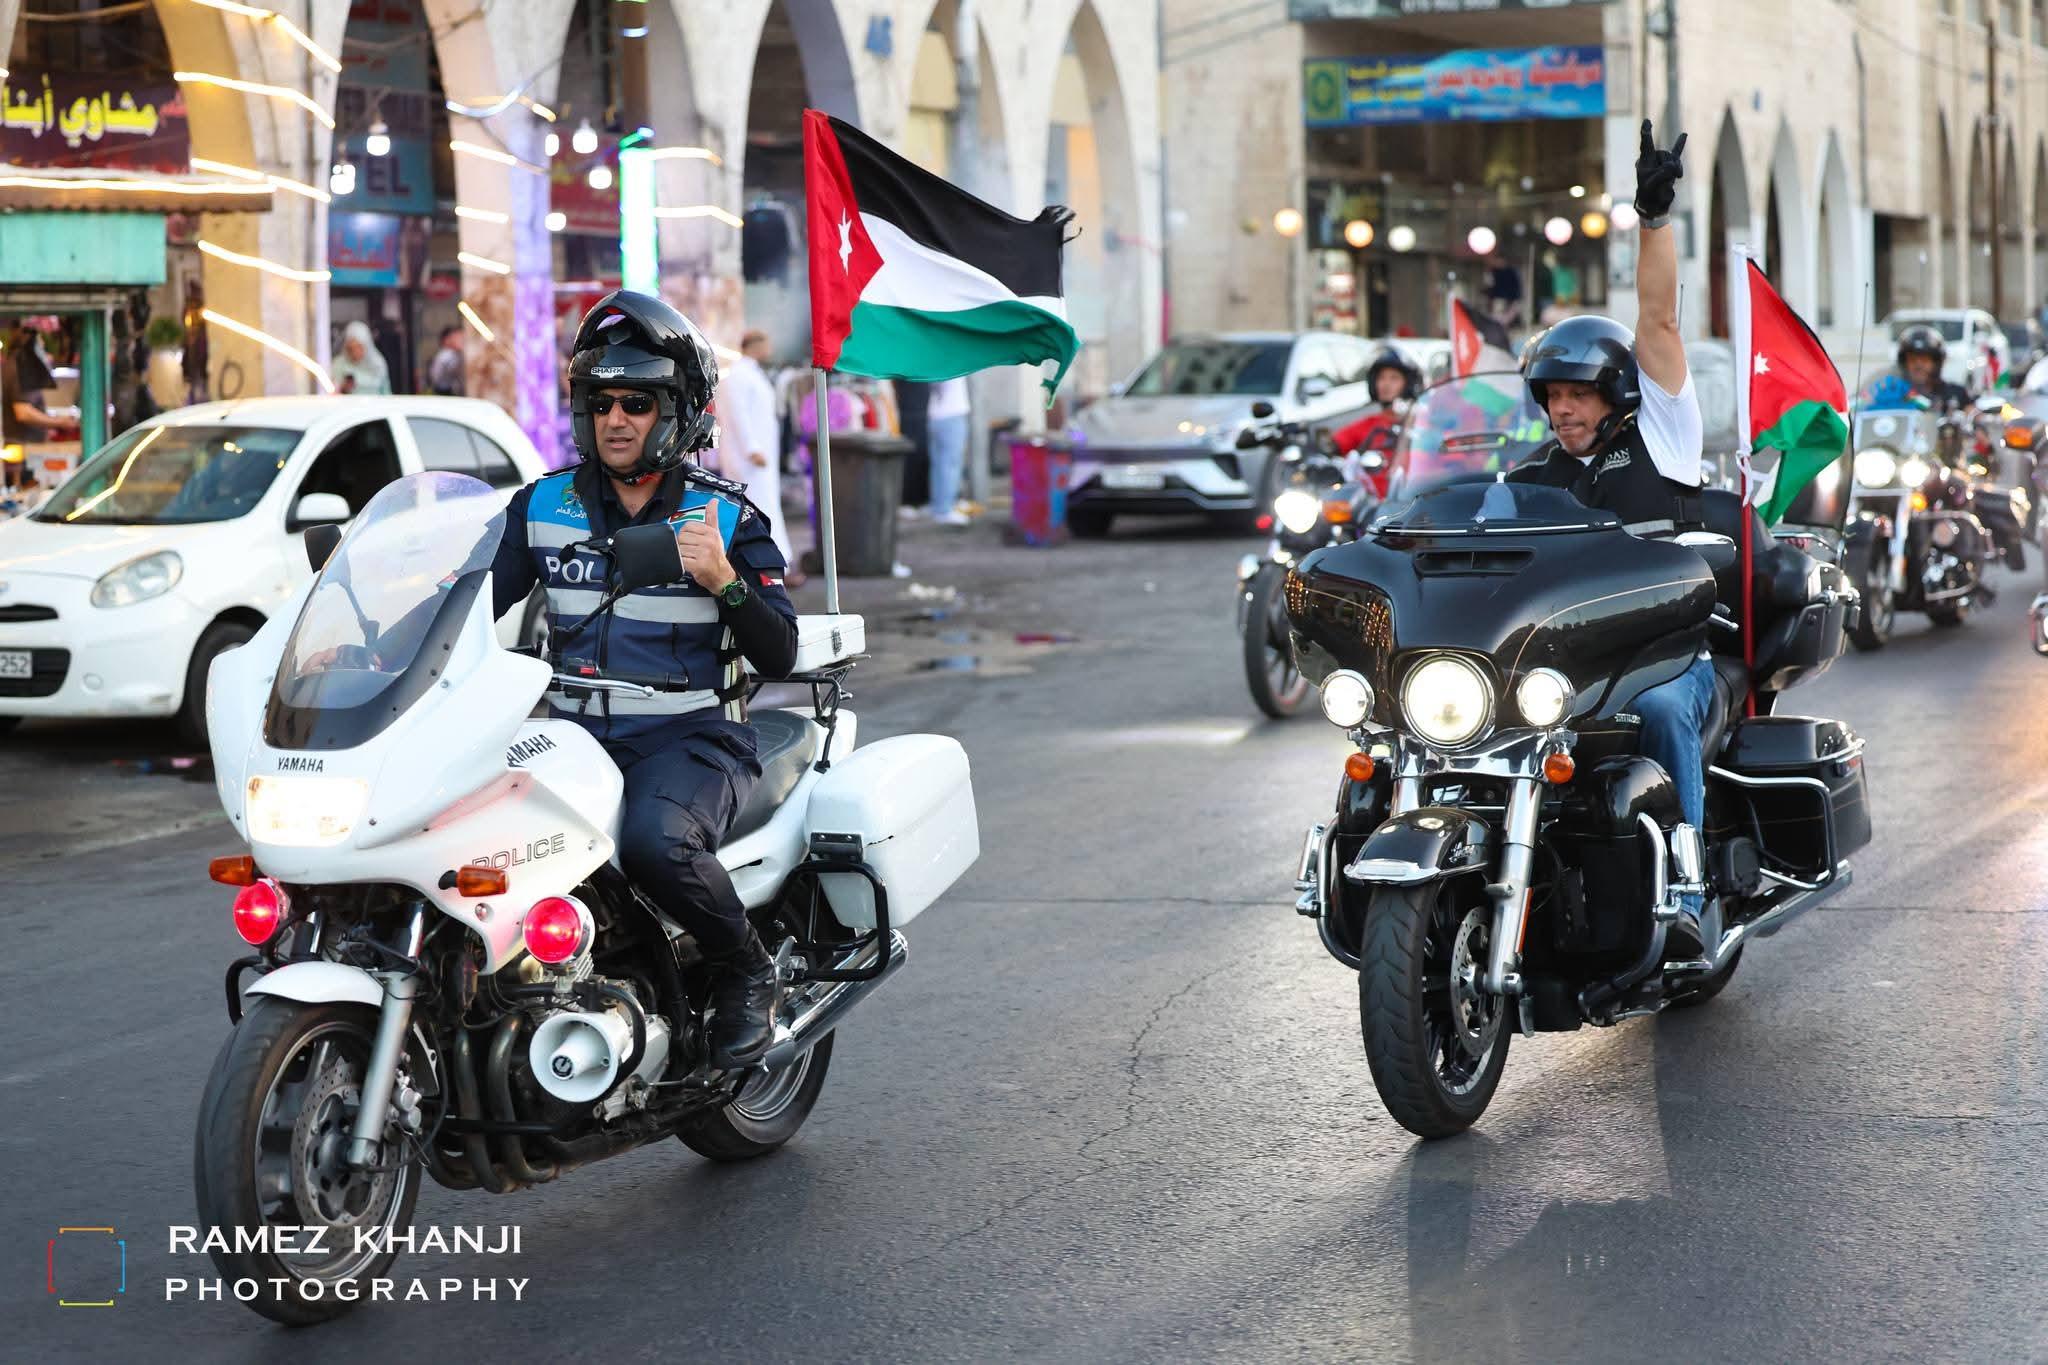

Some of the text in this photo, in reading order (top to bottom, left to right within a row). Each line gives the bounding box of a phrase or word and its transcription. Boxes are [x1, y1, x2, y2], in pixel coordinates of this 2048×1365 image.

[0, 73, 55, 138] أبنا
[60, 91, 159, 148] مشاوي
[277, 757, 324, 773] YAMAHA
[506, 734, 557, 768] AMAHA
